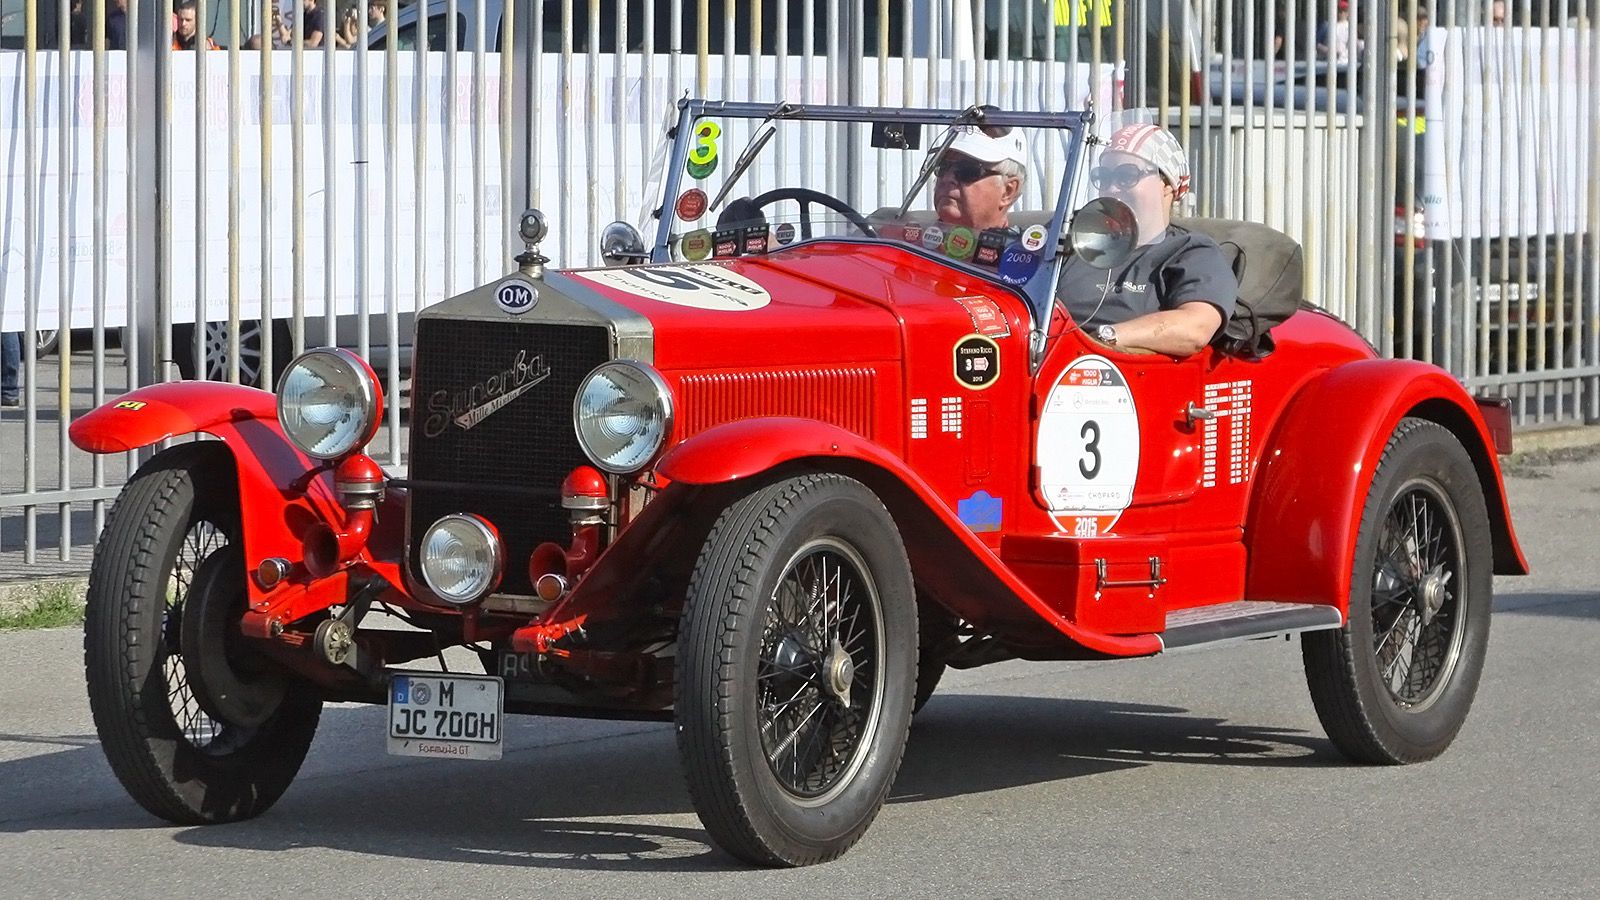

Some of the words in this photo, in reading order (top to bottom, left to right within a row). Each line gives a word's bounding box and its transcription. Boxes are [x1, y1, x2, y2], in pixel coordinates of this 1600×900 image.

[689, 121, 720, 165] 3
[1006, 252, 1033, 264] 2008
[502, 287, 529, 305] OM
[965, 358, 972, 371] 3
[424, 349, 551, 438] Superba
[1079, 420, 1102, 480] 3
[1074, 517, 1098, 532] 2015
[439, 680, 454, 707] M
[395, 708, 427, 735] JC
